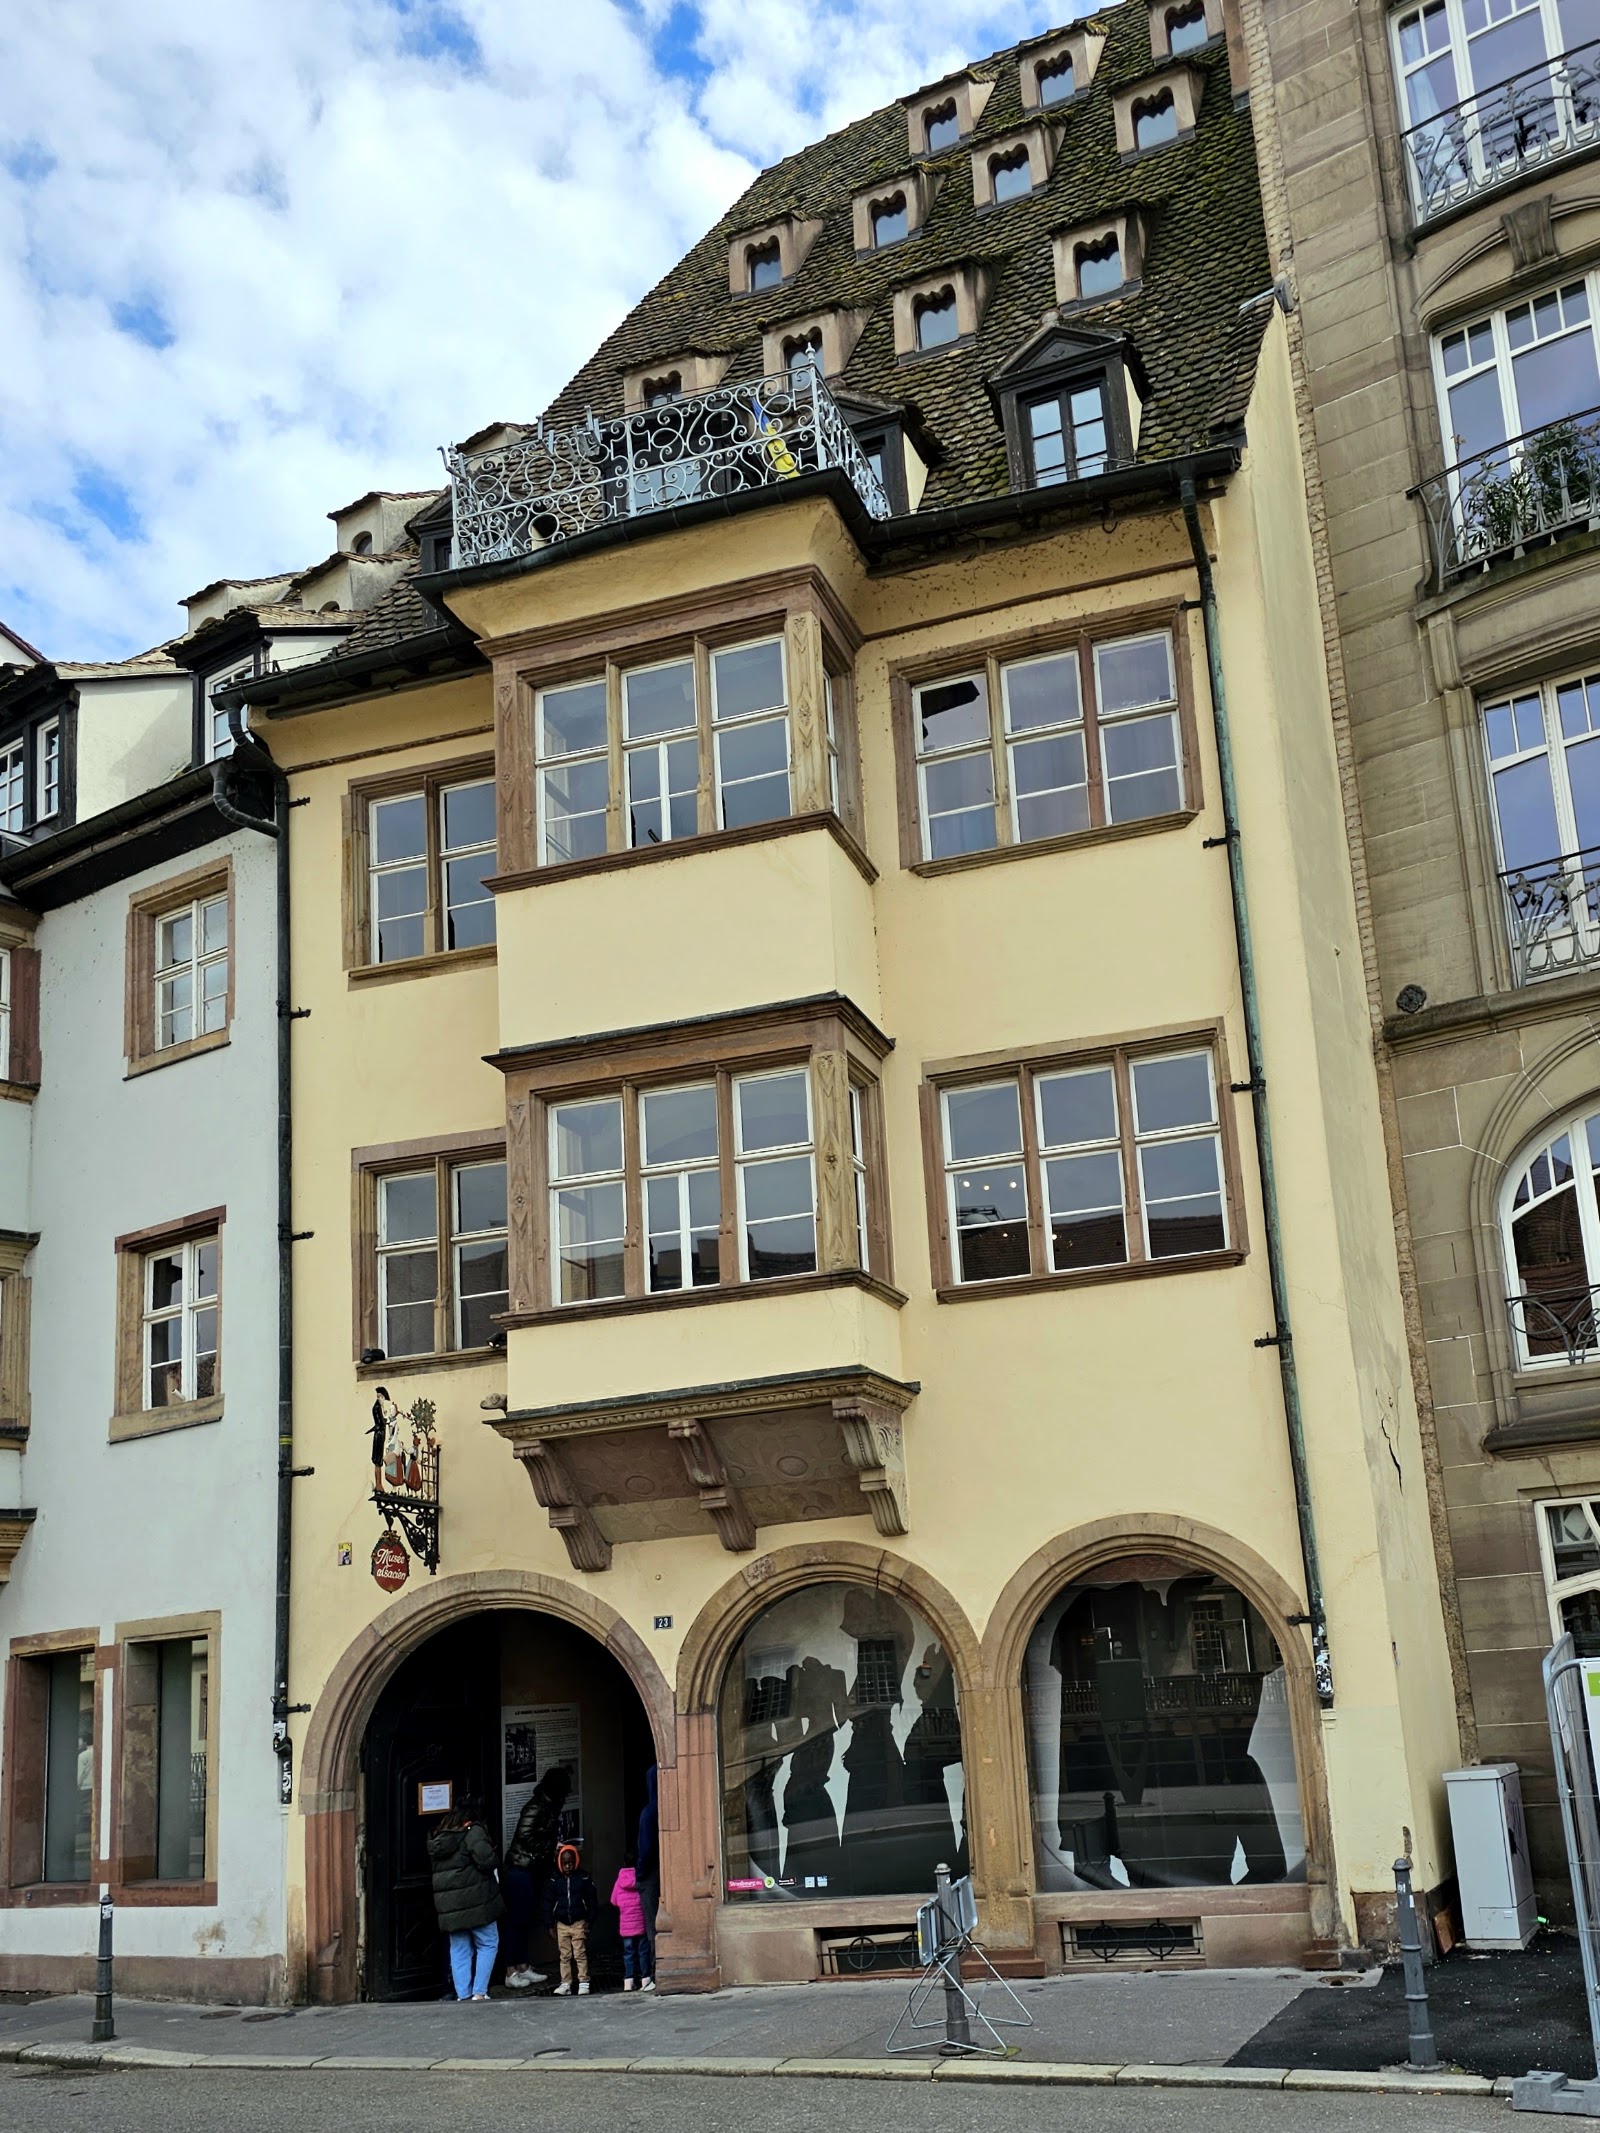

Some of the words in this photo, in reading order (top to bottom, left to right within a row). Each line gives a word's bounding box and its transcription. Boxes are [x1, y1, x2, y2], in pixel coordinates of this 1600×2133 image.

[376, 1548, 405, 1567] Musée
[376, 1565, 406, 1580] alsacien
[658, 1617, 668, 1628] 23
